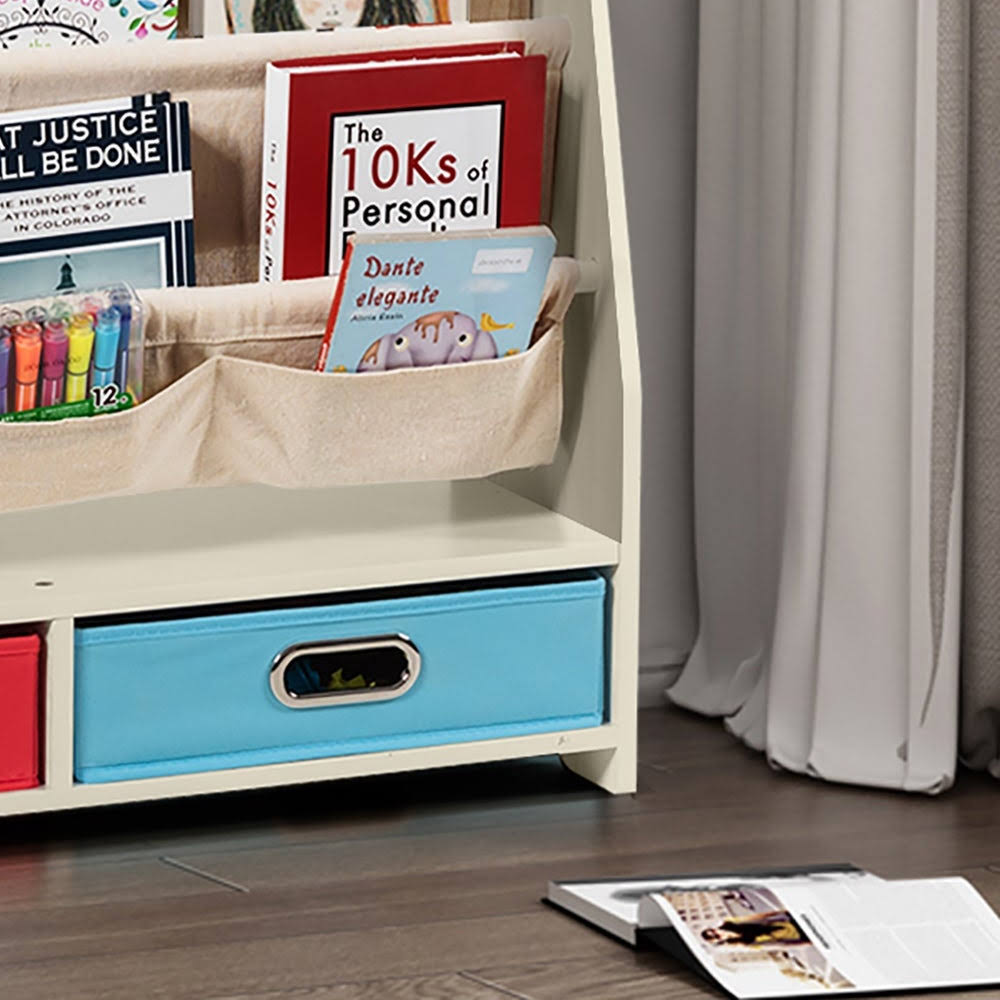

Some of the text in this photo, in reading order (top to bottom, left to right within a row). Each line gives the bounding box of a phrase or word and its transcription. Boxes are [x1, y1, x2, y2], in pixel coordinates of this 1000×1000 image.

[33, 109, 158, 146] JUSTICE
[344, 122, 383, 144] The
[43, 149, 78, 175] BE
[86, 139, 161, 169] DONE
[342, 140, 489, 191] 10Ks of
[19, 192, 81, 207] HISTORY
[84, 189, 102, 199] OF
[108, 184, 136, 195] THE
[95, 196, 147, 210] OFFICE
[343, 182, 489, 228] Personal
[13, 213, 112, 233] IN COLORADO
[364, 256, 425, 278] Dante
[356, 287, 440, 310] elegante
[93, 386, 116, 406] 12
